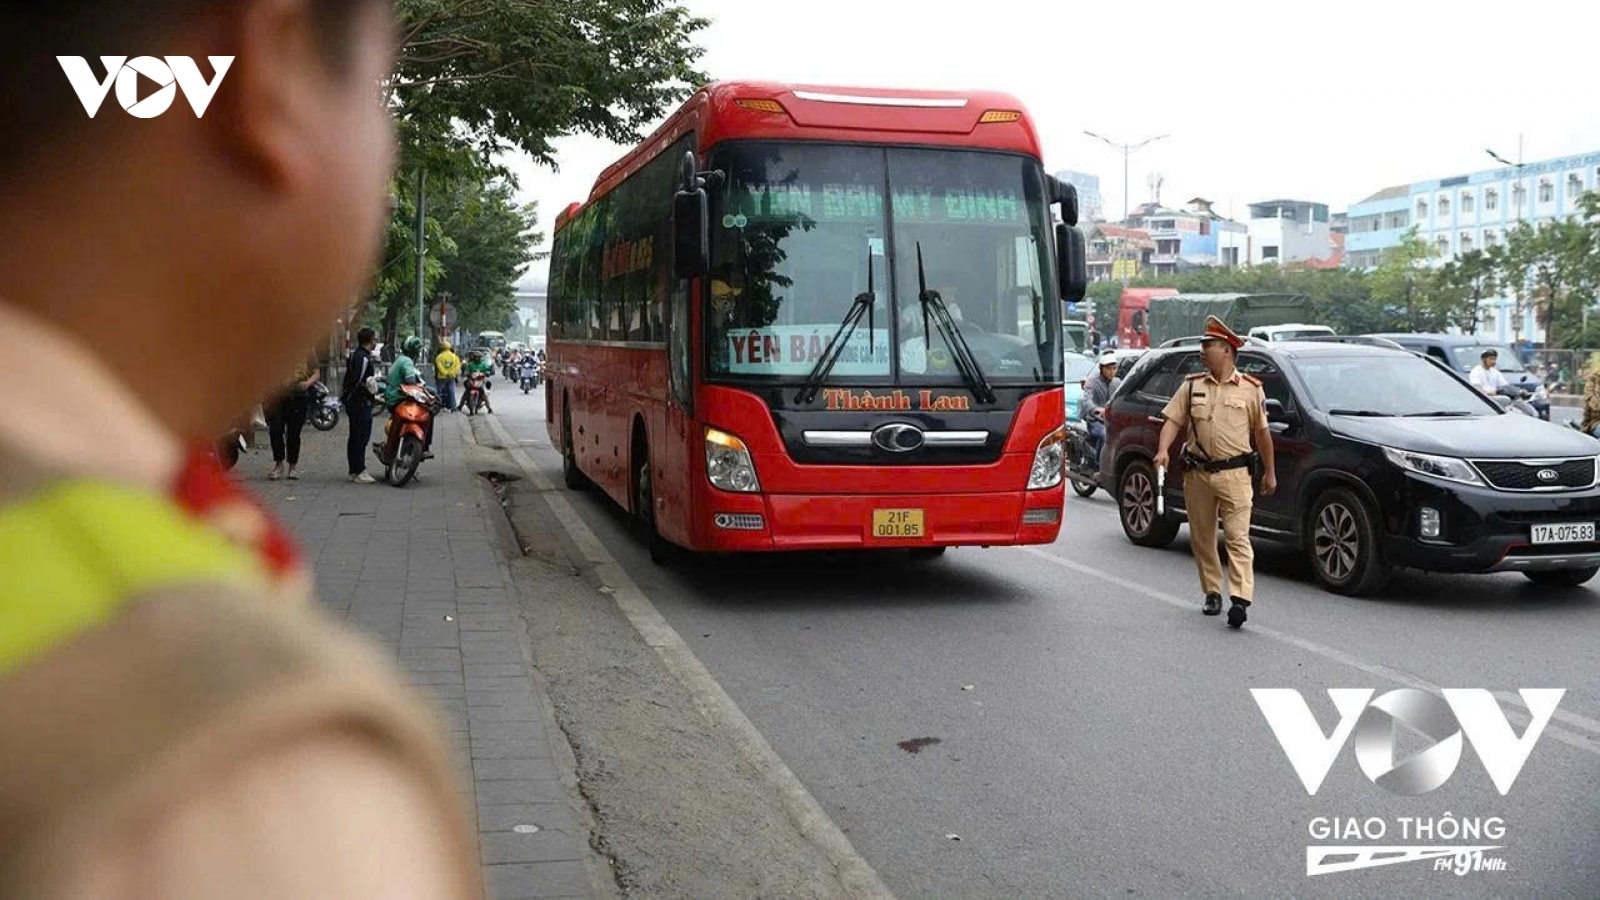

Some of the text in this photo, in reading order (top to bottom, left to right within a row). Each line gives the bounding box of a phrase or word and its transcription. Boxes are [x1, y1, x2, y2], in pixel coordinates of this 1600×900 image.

[731, 330, 781, 364] YÊN
[823, 388, 970, 411] Thành Lan
[888, 511, 910, 523] 21F
[878, 524, 919, 536] 001.85
[1534, 525, 1593, 541] 17A-075.83
